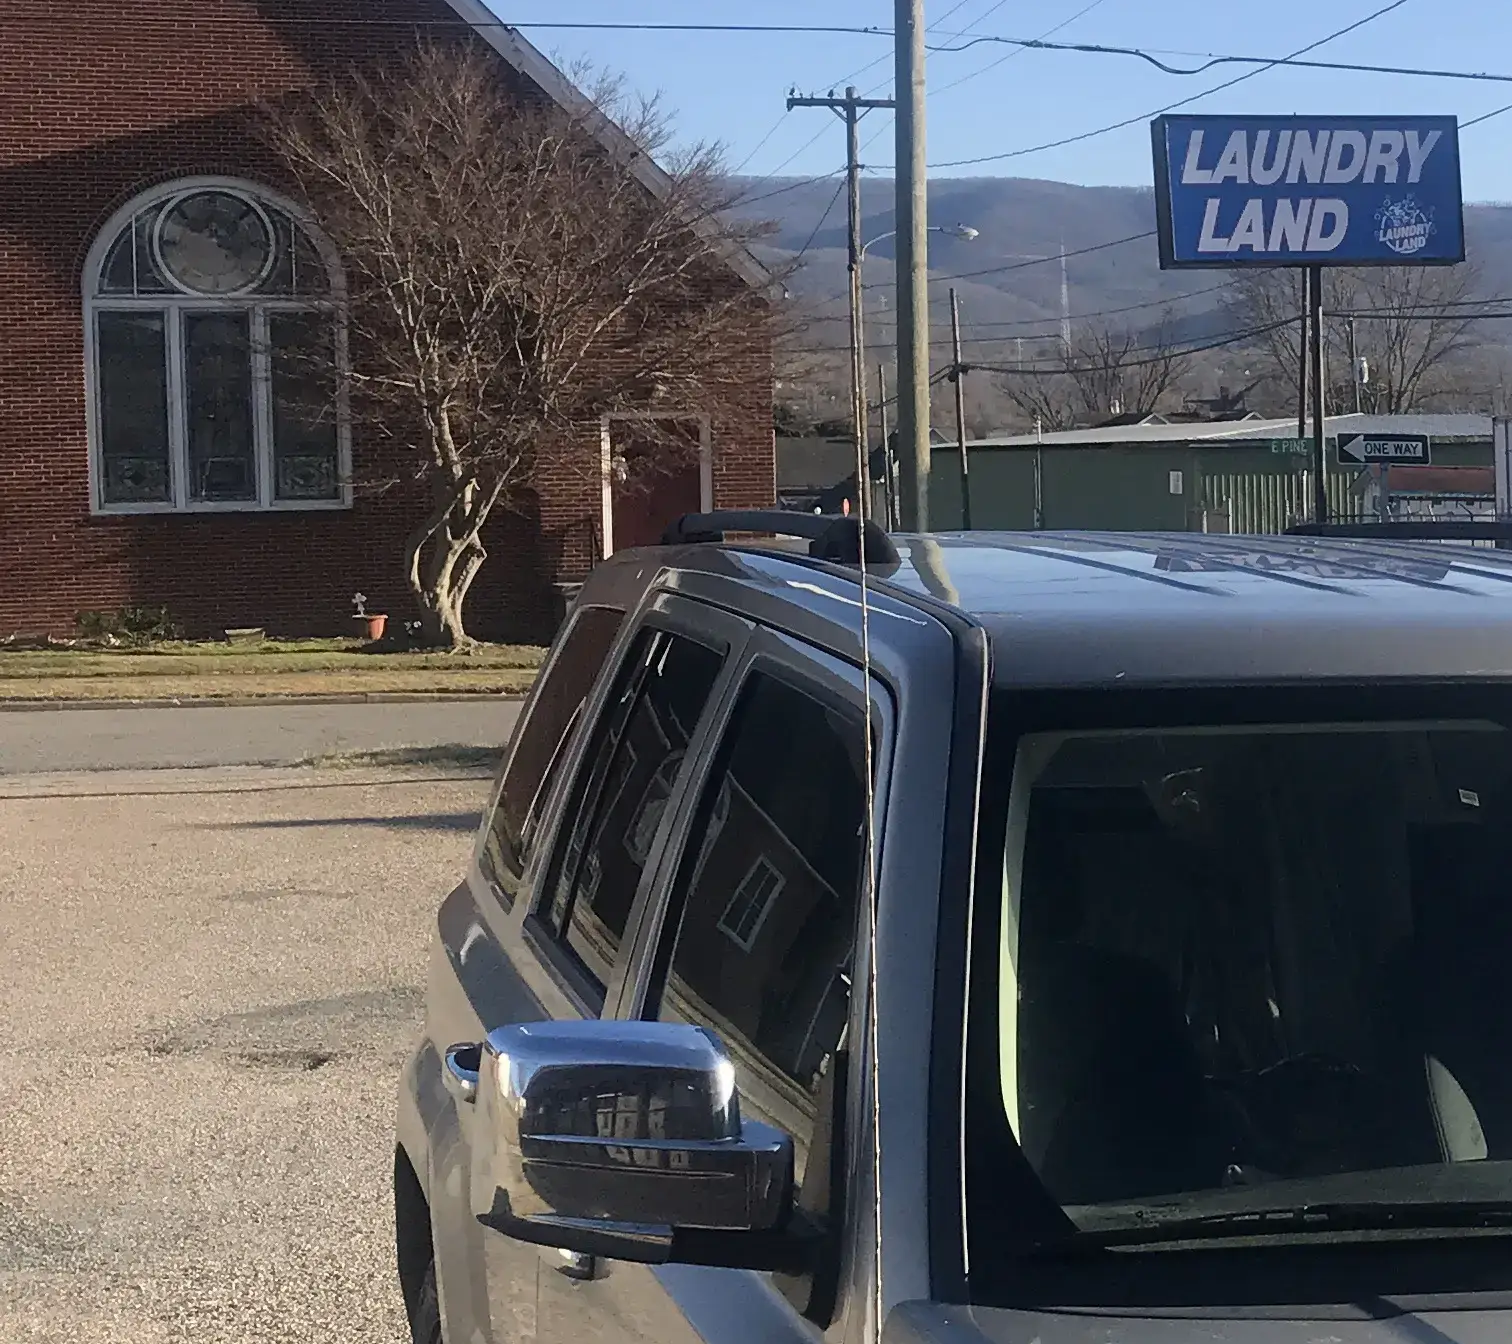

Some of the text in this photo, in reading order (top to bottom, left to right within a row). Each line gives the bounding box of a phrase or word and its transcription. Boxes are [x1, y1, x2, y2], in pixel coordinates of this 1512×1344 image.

[1181, 130, 1442, 185] LAUNDRY
[1197, 198, 1349, 252] LAND
[1379, 222, 1432, 242] LAUNDRY
[1395, 236, 1426, 252] LAND
[1271, 440, 1308, 454] E PINE
[1364, 442, 1419, 456] ONE WAY
